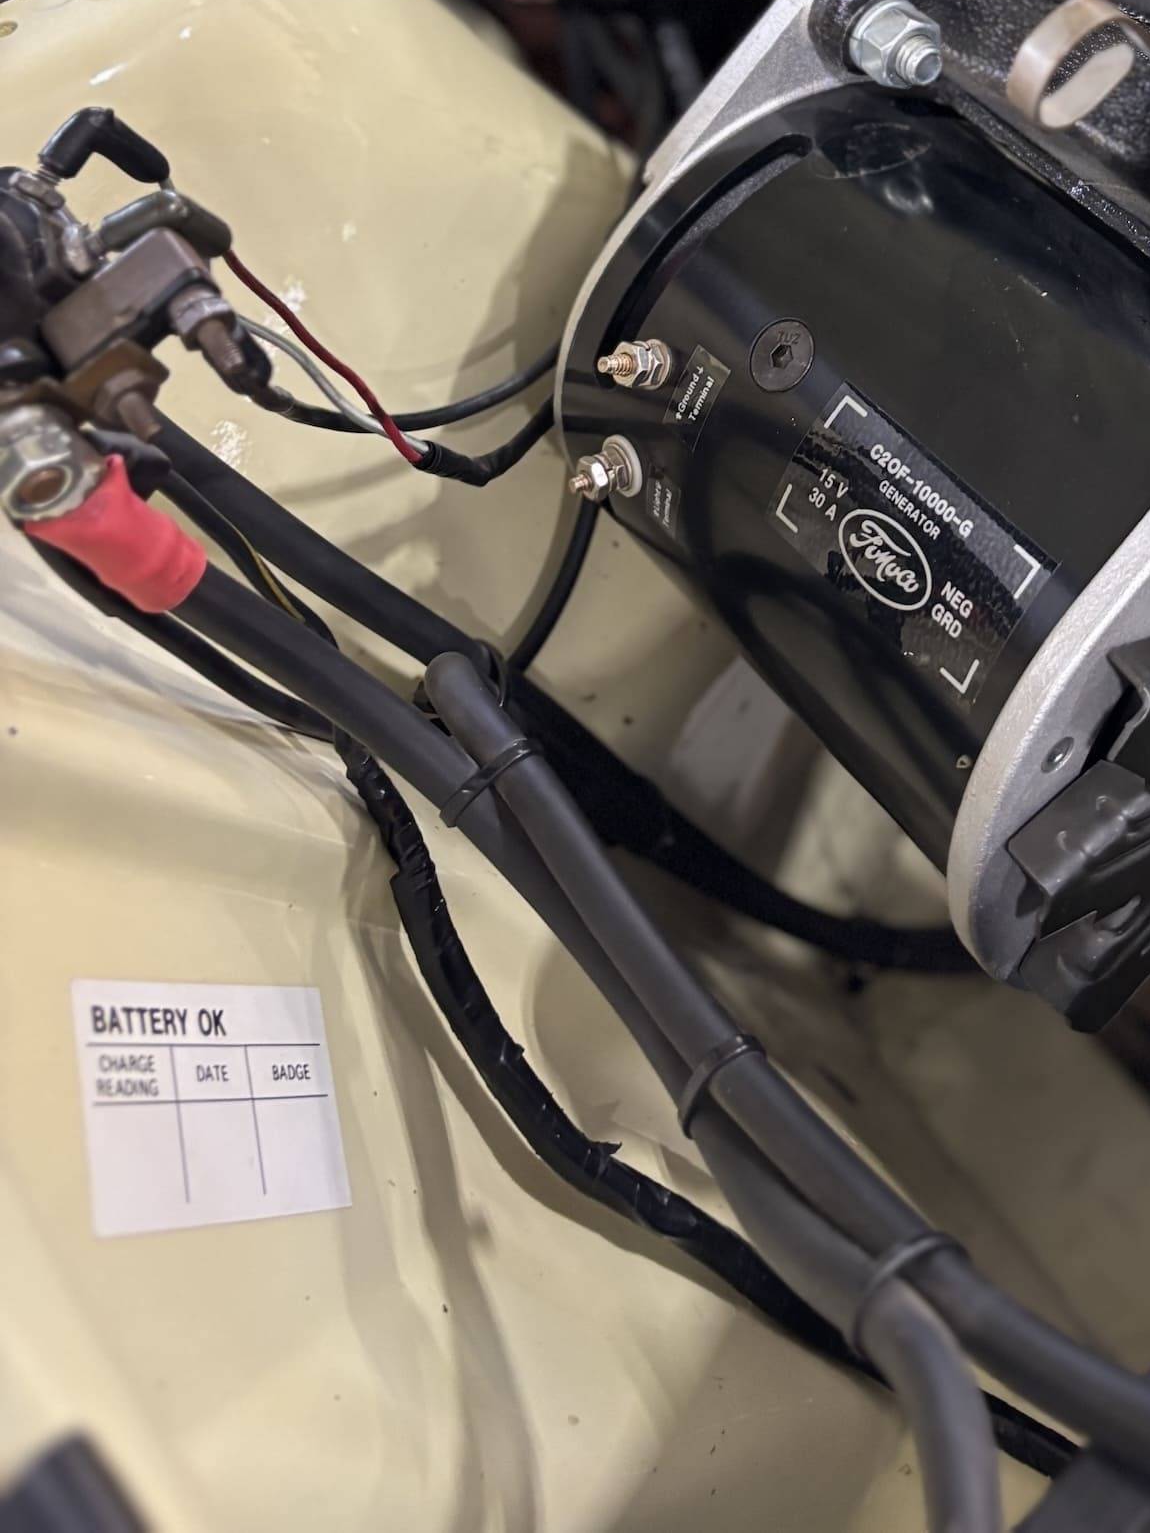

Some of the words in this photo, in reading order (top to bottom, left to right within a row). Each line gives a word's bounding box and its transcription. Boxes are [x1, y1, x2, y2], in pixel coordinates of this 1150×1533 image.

[677, 372, 700, 413] Ground
[688, 376, 715, 421] Terminal
[819, 468, 836, 489] 15
[836, 482, 849, 499] V
[808, 487, 826, 508] 30
[825, 504, 838, 522] A
[879, 479, 941, 541] GENERATOR
[940, 581, 974, 619] NEG
[931, 603, 963, 638] GRD
[91, 1005, 187, 1036] BATTERY
[199, 1009, 227, 1036] OK
[98, 1054, 156, 1073] CHARGE
[196, 1065, 229, 1082] DATE
[272, 1064, 311, 1081] BADGE
[96, 1078, 160, 1098] READING
